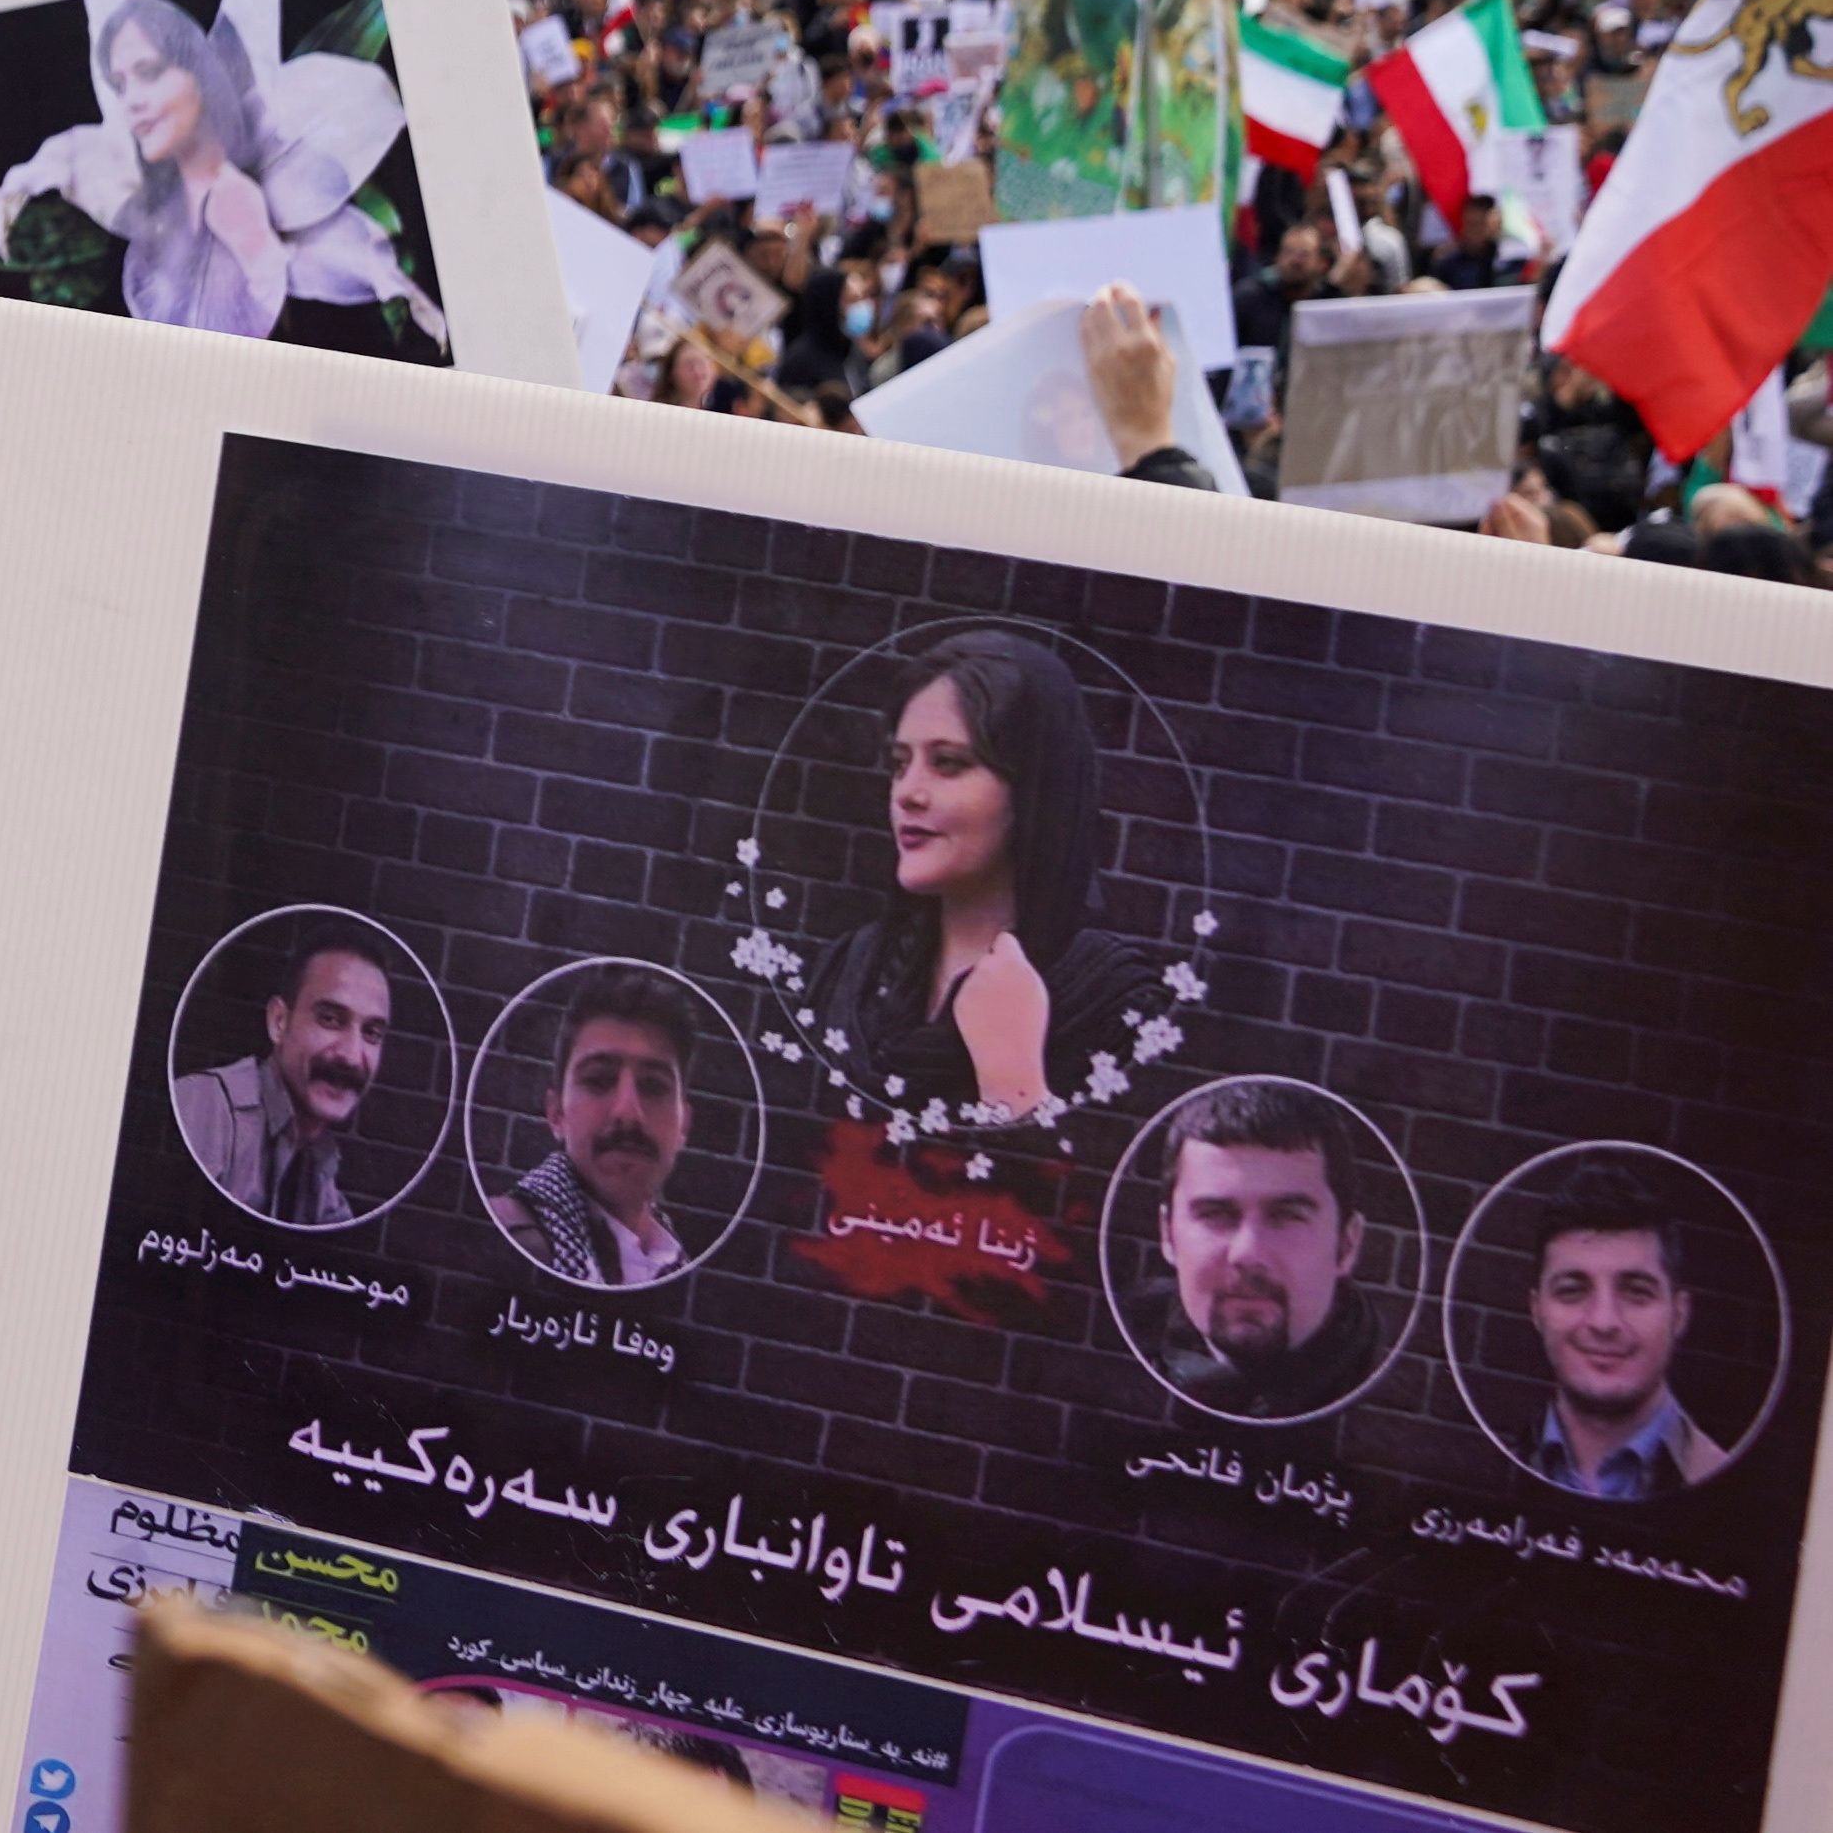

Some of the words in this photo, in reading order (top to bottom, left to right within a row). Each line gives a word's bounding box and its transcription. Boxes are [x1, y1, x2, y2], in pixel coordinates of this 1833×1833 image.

[275, 1265, 410, 1309] موحسن
[1124, 1446, 1243, 1486] فاتحی
[1255, 1463, 1353, 1525] پژمان
[111, 1499, 241, 1553] مظلوم
[642, 1493, 907, 1601] تاوانباری
[254, 1548, 399, 1594] محسن
[930, 1568, 1243, 1683] ئیسلامی
